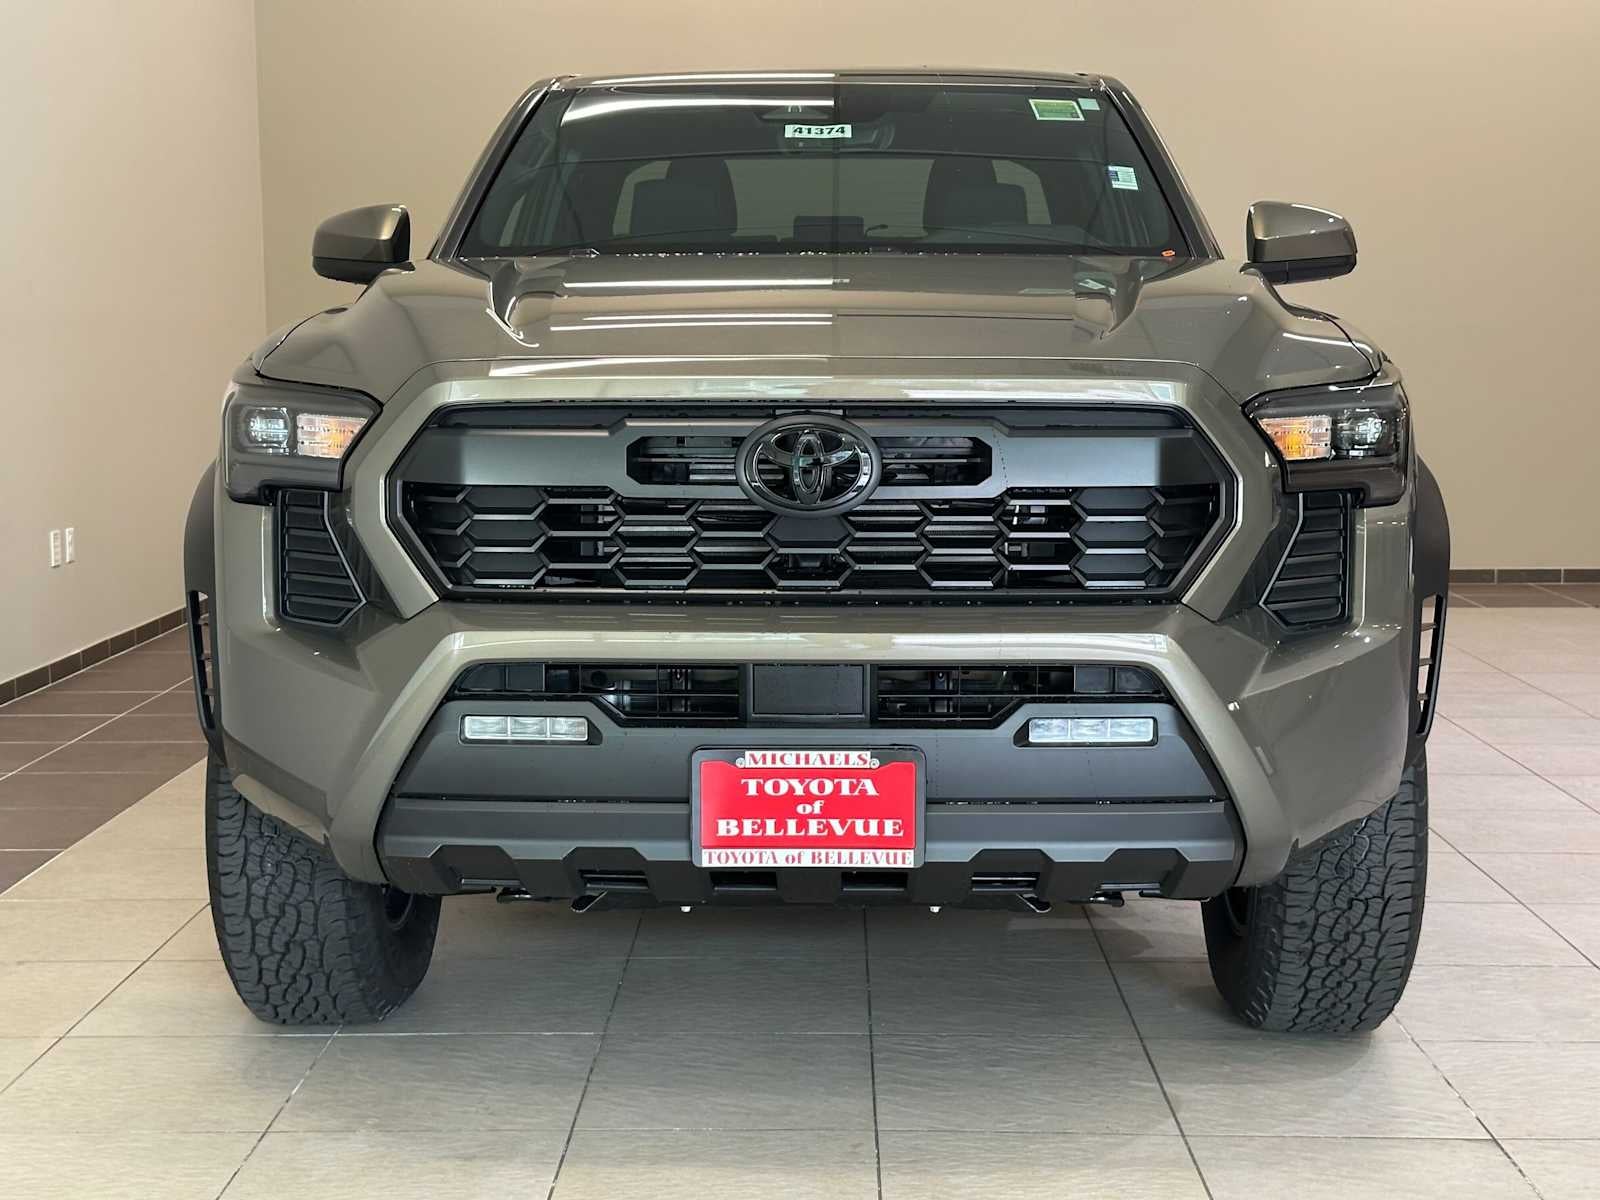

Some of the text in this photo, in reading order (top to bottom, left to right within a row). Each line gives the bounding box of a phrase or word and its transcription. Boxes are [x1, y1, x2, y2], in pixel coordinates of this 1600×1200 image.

[793, 126, 846, 135] 41374
[748, 752, 869, 766] MICHAELS
[741, 778, 879, 797] TOYOTA
[796, 799, 825, 815] of
[716, 818, 904, 837] BELLEVUE
[704, 851, 913, 866] TOYOTA of BELLEVUE
